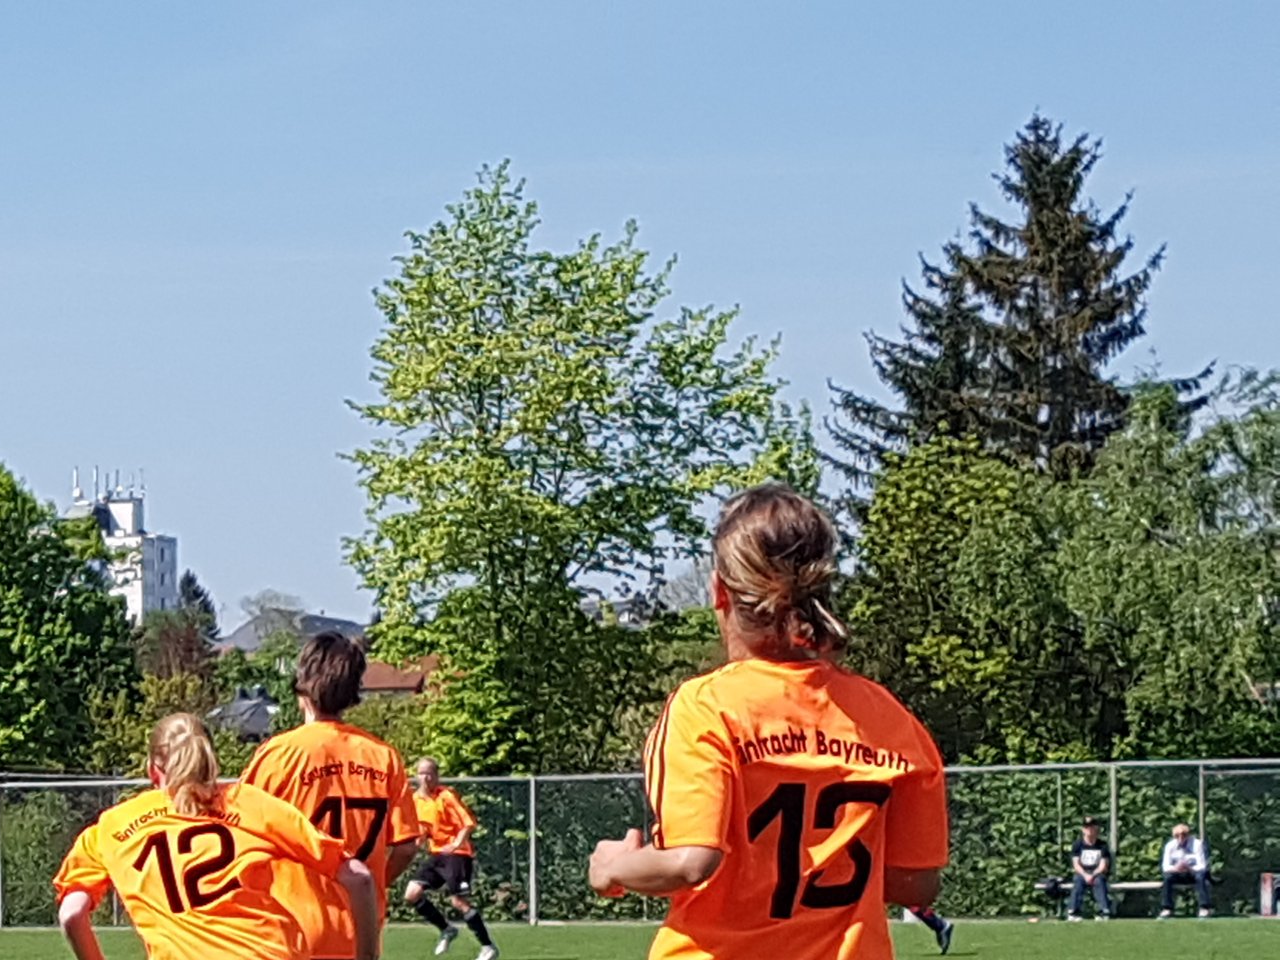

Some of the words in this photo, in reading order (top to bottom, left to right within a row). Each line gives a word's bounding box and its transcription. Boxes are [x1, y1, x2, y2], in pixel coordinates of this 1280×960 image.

[816, 729, 909, 772] Bayreuth
[310, 796, 387, 862] 17
[747, 780, 892, 920] 13
[133, 823, 241, 914] 12
